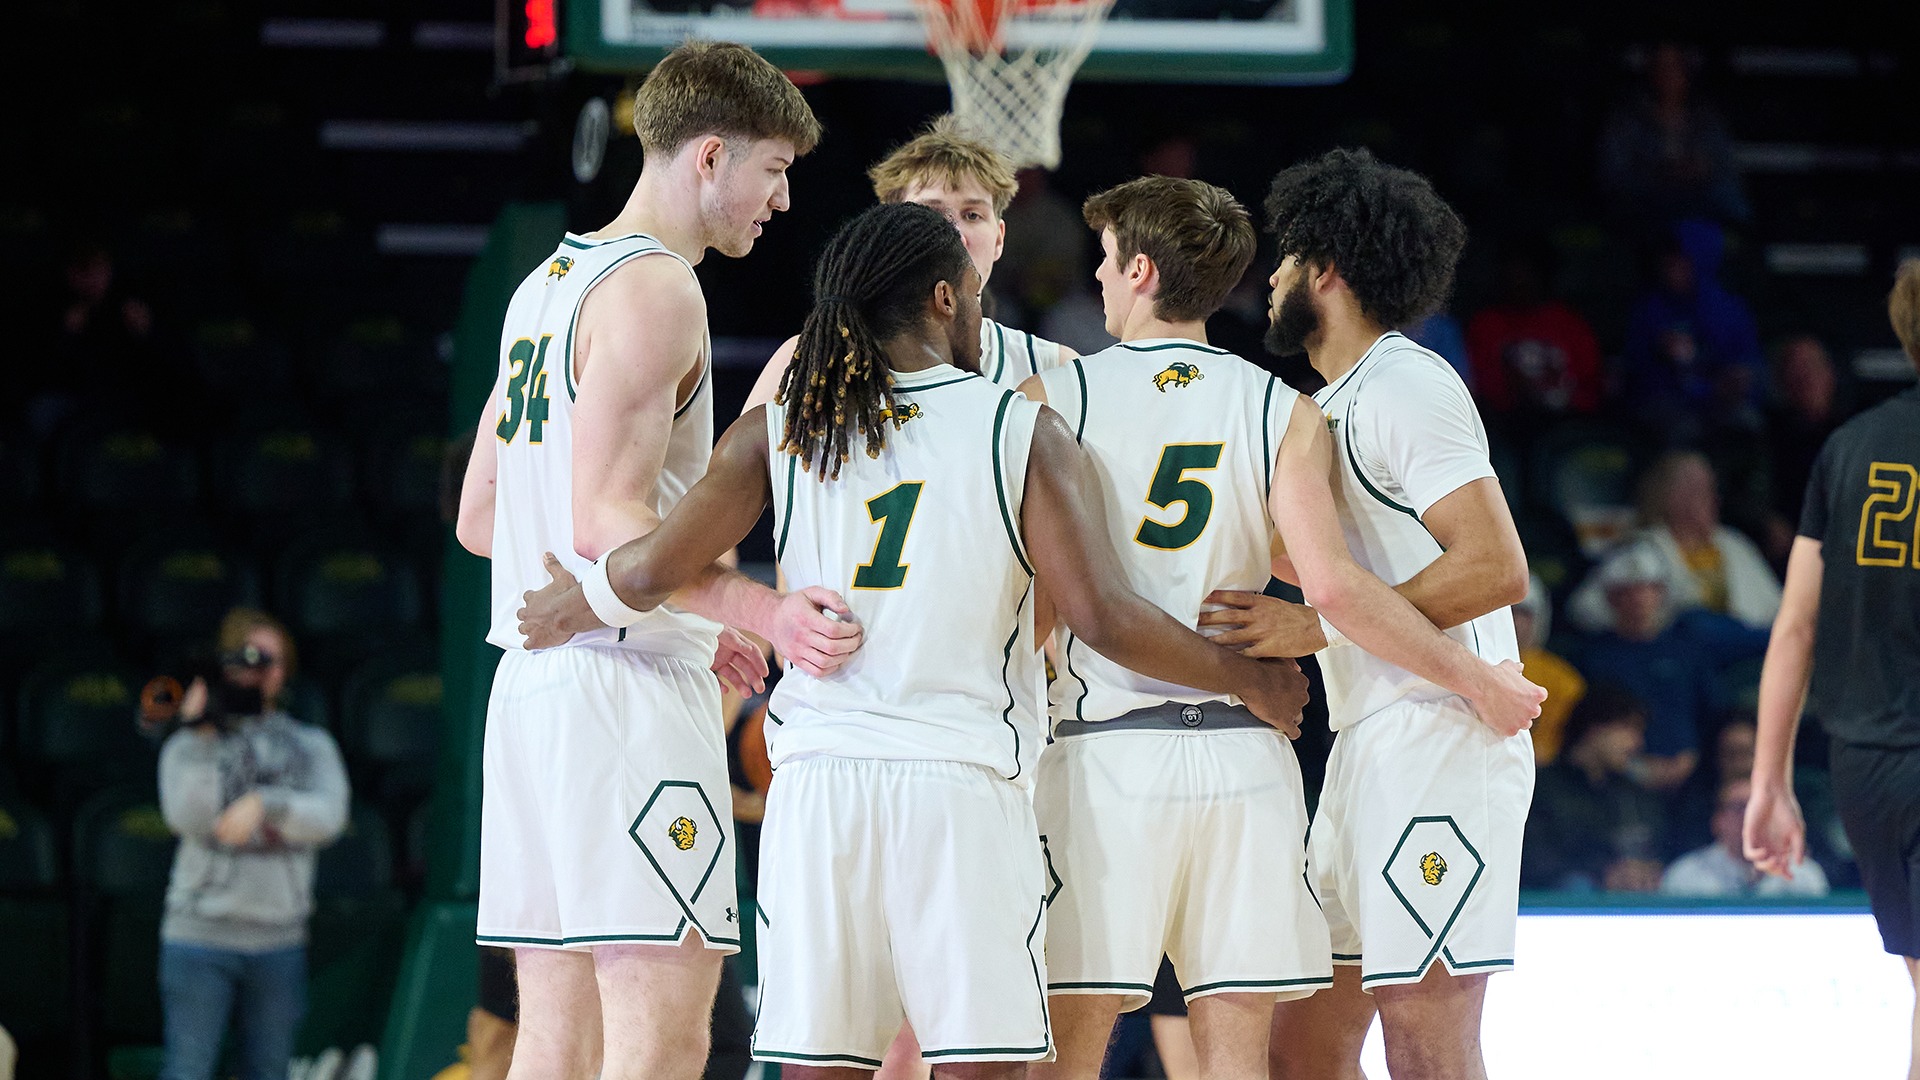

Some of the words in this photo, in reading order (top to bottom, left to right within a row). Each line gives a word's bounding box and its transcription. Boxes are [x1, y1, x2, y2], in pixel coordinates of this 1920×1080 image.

[496, 333, 554, 446] 34
[851, 480, 926, 591] 1
[1133, 441, 1226, 551] 5
[1856, 461, 1920, 570] 2
